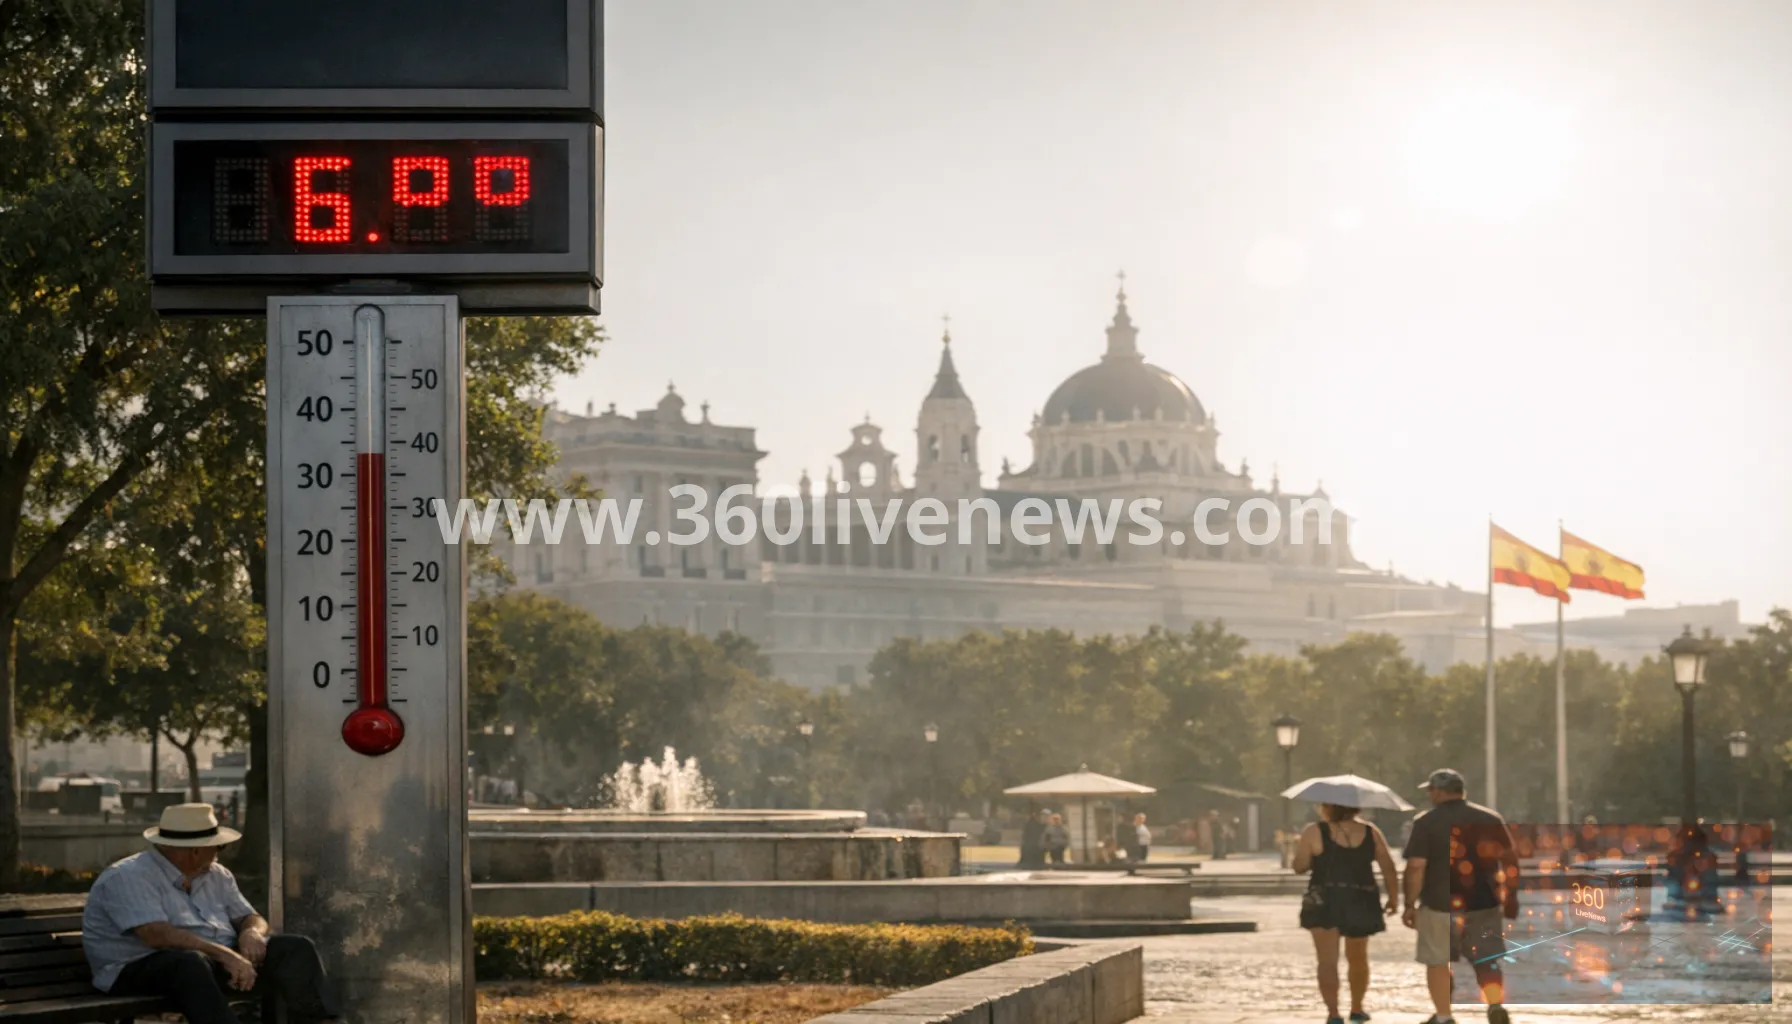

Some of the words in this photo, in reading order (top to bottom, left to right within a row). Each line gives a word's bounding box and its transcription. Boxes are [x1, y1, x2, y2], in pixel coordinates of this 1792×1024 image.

[297, 329, 333, 357] 50
[411, 368, 438, 390] 50
[296, 395, 334, 423] 40
[410, 431, 439, 454] 40
[297, 462, 334, 490] 30
[411, 496, 438, 519] 30
[297, 528, 334, 556] 20
[411, 560, 439, 583] 20
[298, 595, 334, 622] 10
[412, 624, 439, 647] 10
[312, 660, 331, 689] 0
